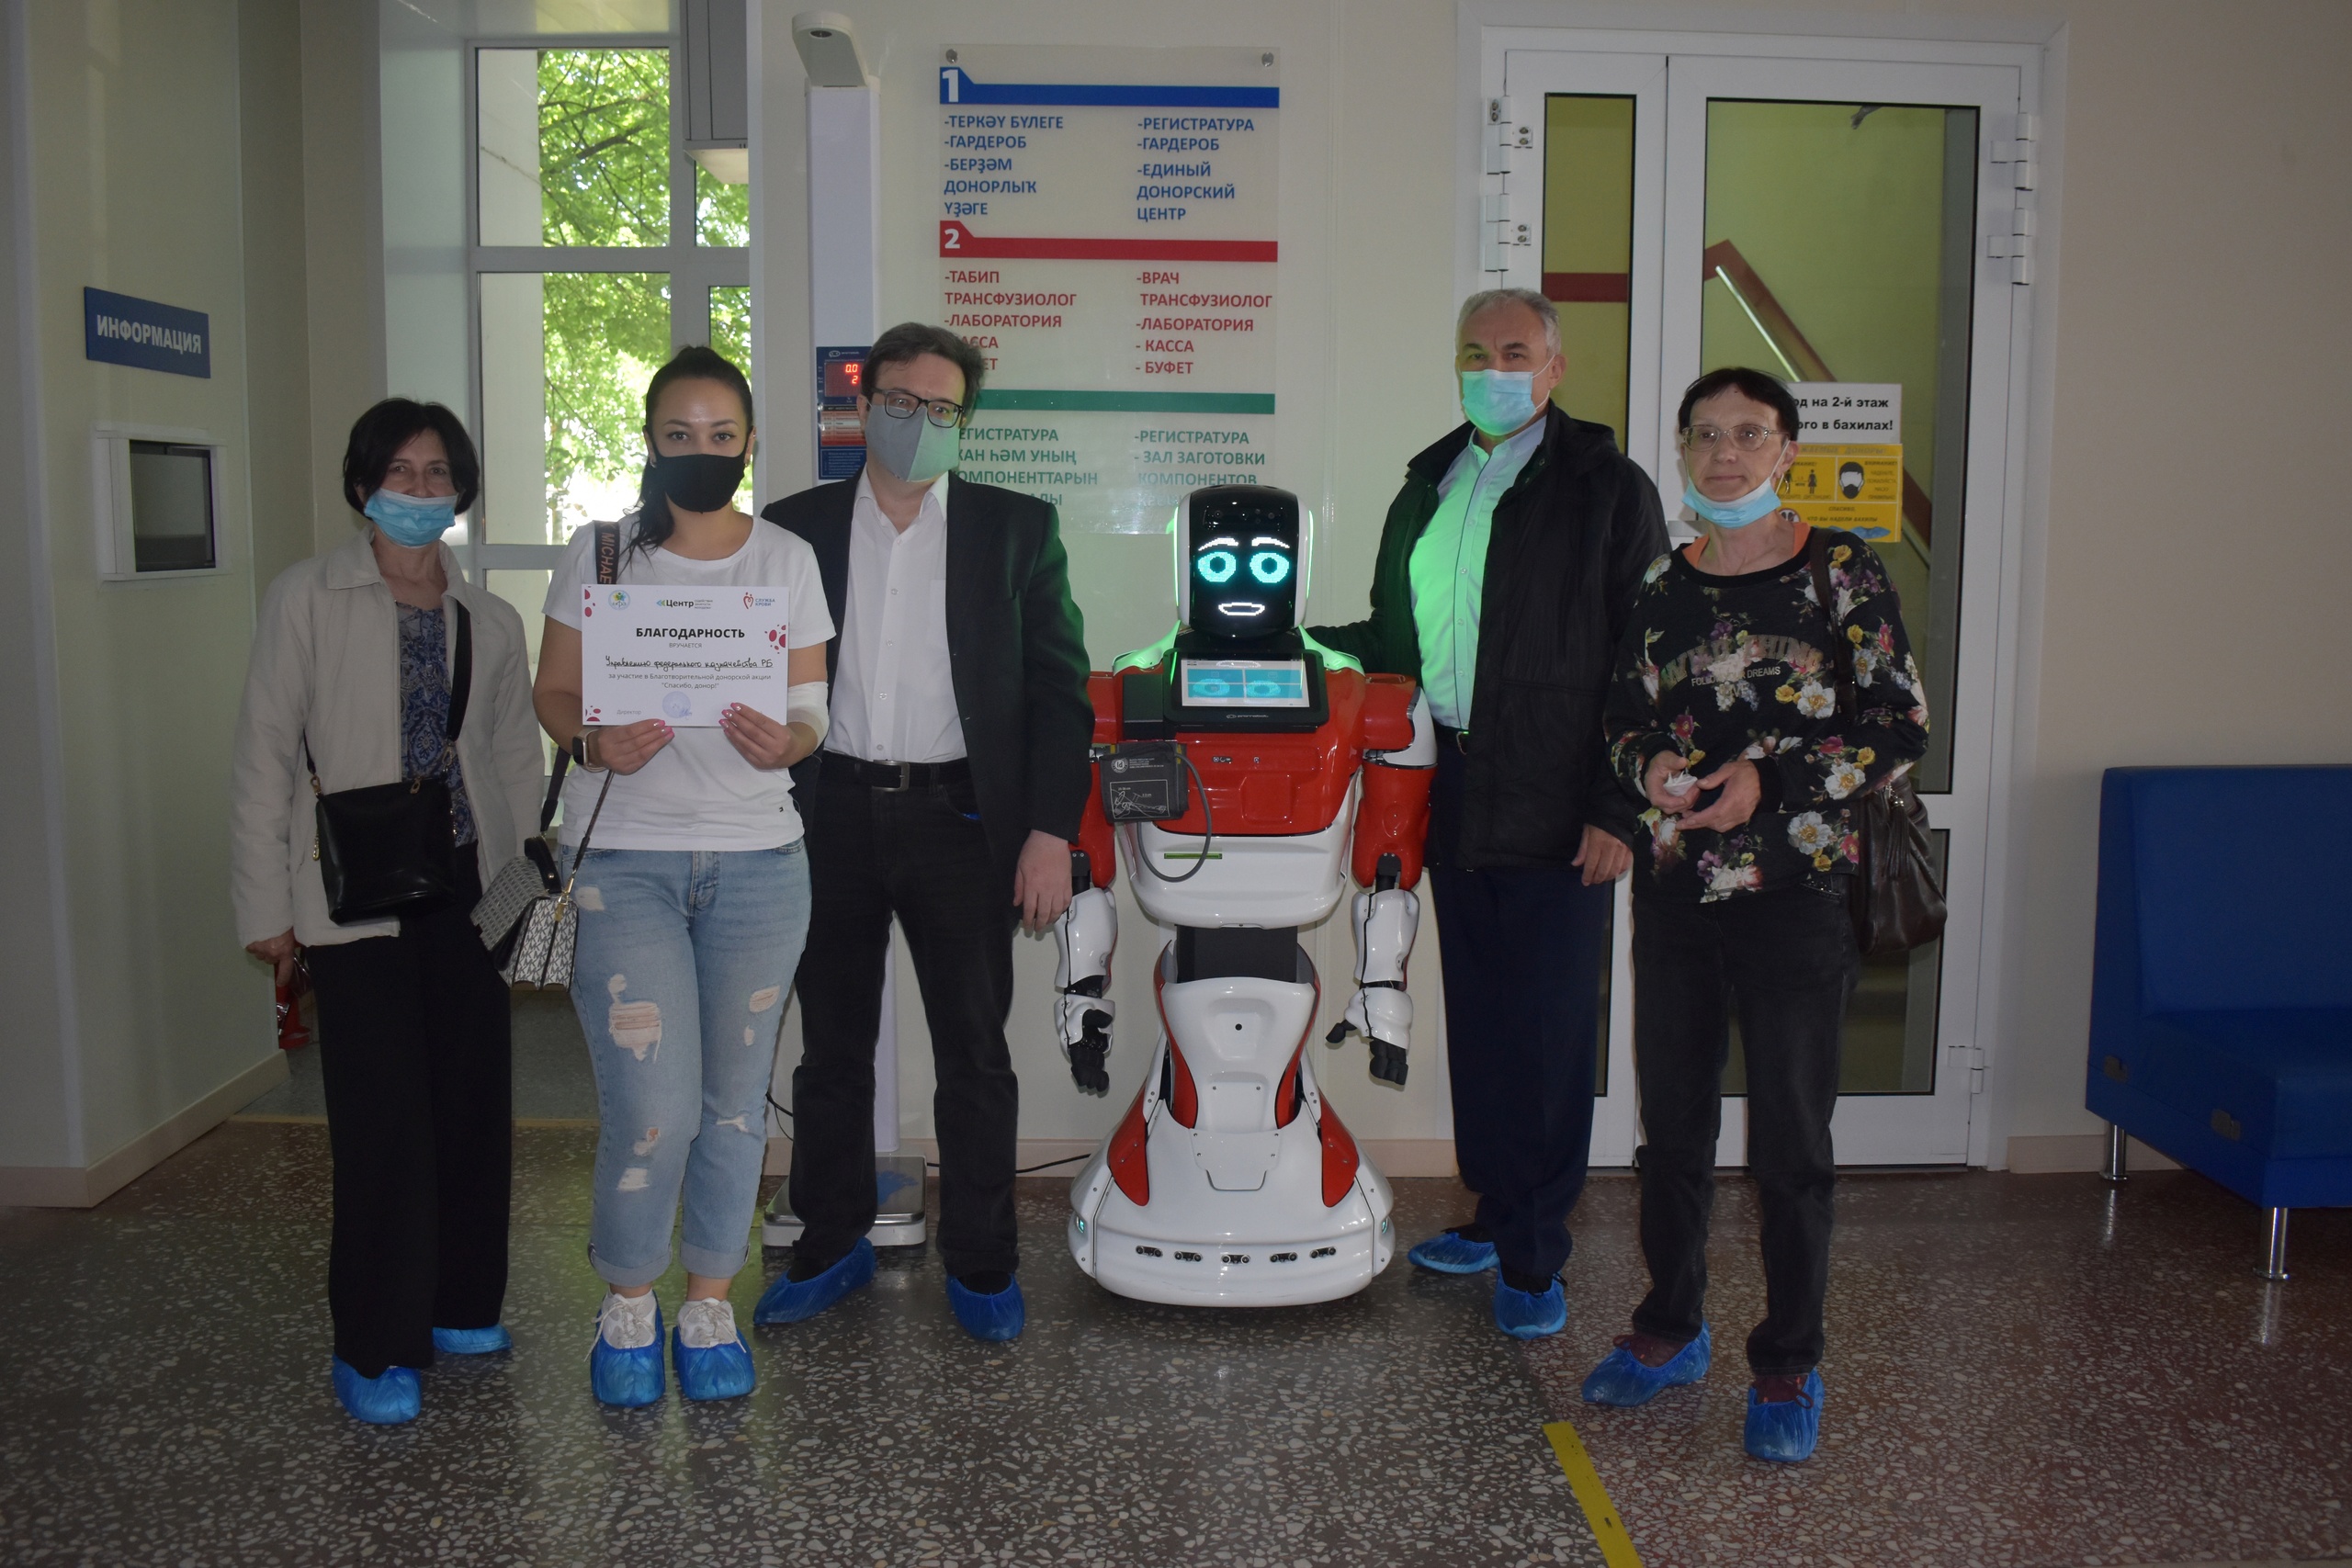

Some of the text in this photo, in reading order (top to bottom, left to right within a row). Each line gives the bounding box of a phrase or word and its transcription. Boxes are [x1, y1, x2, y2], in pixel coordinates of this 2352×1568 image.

[942, 69, 959, 103] 1
[1137, 118, 1255, 132] -РЕГИСТРАТУРА
[944, 135, 1027, 151] -ГАРДЕРОБ
[1137, 138, 1220, 153] -ГАРДЕРОБ
[1137, 162, 1212, 177] -ЕДИНЫЙ
[1136, 185, 1235, 201] ДОНОРСКИЙ
[1137, 208, 1186, 222] ЦЕНТР
[944, 228, 961, 249] 2
[944, 292, 1077, 307] ТРАНСФУЗИОЛОГ
[1140, 293, 1273, 309] ТРАНСФУЗИОЛОГ
[96, 314, 201, 355] ИНФОРМАЦИЯ
[959, 335, 999, 349] АССА
[1145, 338, 1194, 353] КАССА
[1145, 360, 1194, 375] БУФЕТ
[1812, 399, 1828, 407] на
[1832, 396, 1852, 407] 2-й
[1857, 399, 1889, 408] этаж
[1833, 419, 1894, 431] бахилах!
[959, 428, 1058, 441] ЕГИСТРАТУРА
[1143, 451, 1172, 464] ЗАЛ
[1177, 451, 1265, 466] ЗАГОТОВКИ
[952, 470, 1098, 485] ОМПОНЕНТТАРЫН
[1138, 472, 1257, 486] КОМПОНЕНТОВ
[599, 532, 616, 584] MICHAE
[666, 599, 695, 609] Центр
[636, 627, 745, 640] БЛАГОДАРНОСТЬ
[761, 659, 774, 668] РБ
[1747, 666, 1781, 680] DREAMS
